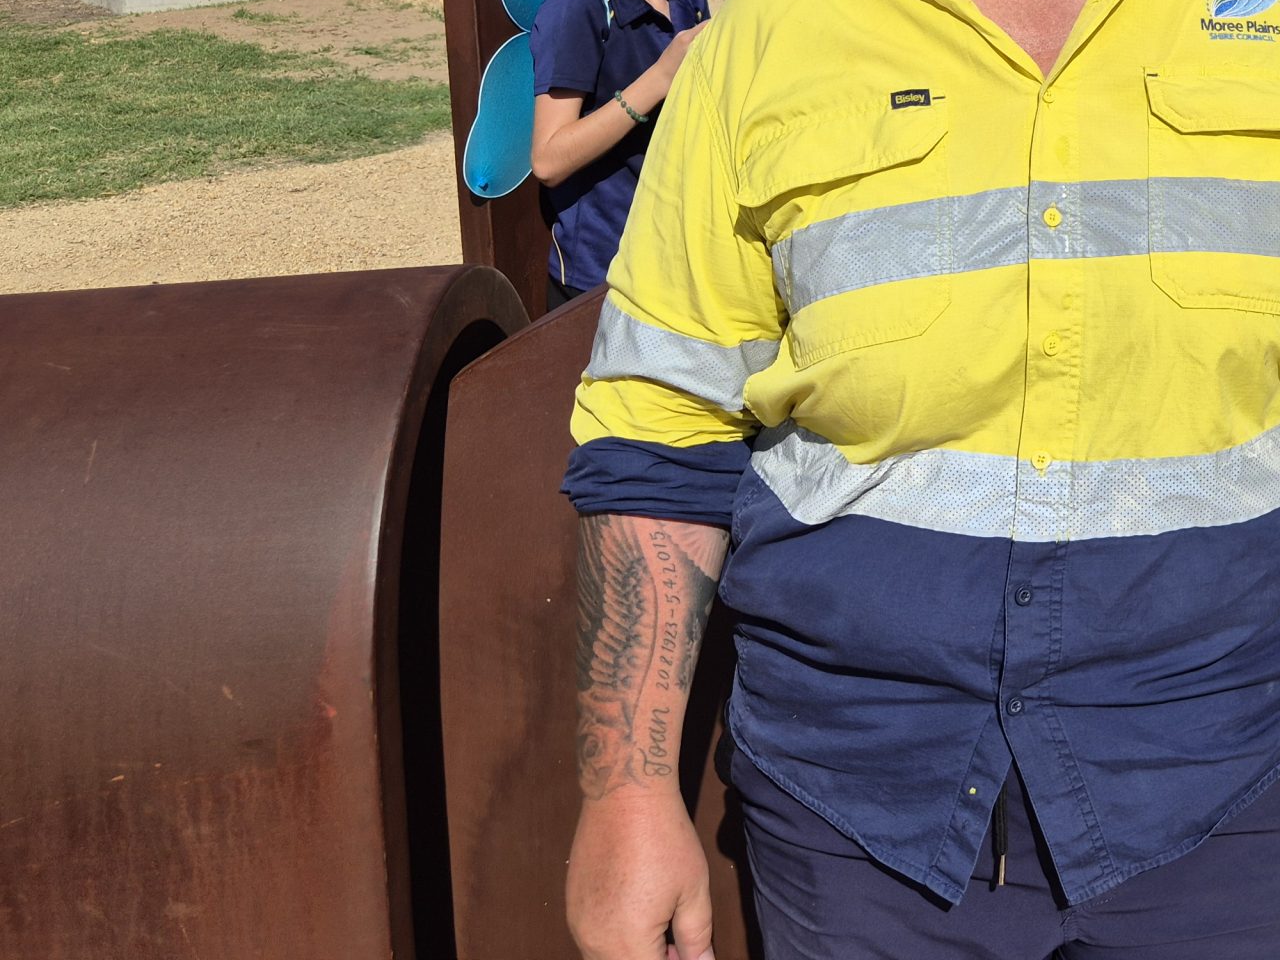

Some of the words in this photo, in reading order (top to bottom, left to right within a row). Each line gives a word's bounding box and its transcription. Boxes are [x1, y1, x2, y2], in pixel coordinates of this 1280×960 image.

[1200, 18, 1244, 33] Moree
[1209, 32, 1235, 40] SHIRE
[1236, 33, 1276, 42] COUNCIL
[895, 93, 925, 105] Bisley
[638, 706, 672, 777] Joan
